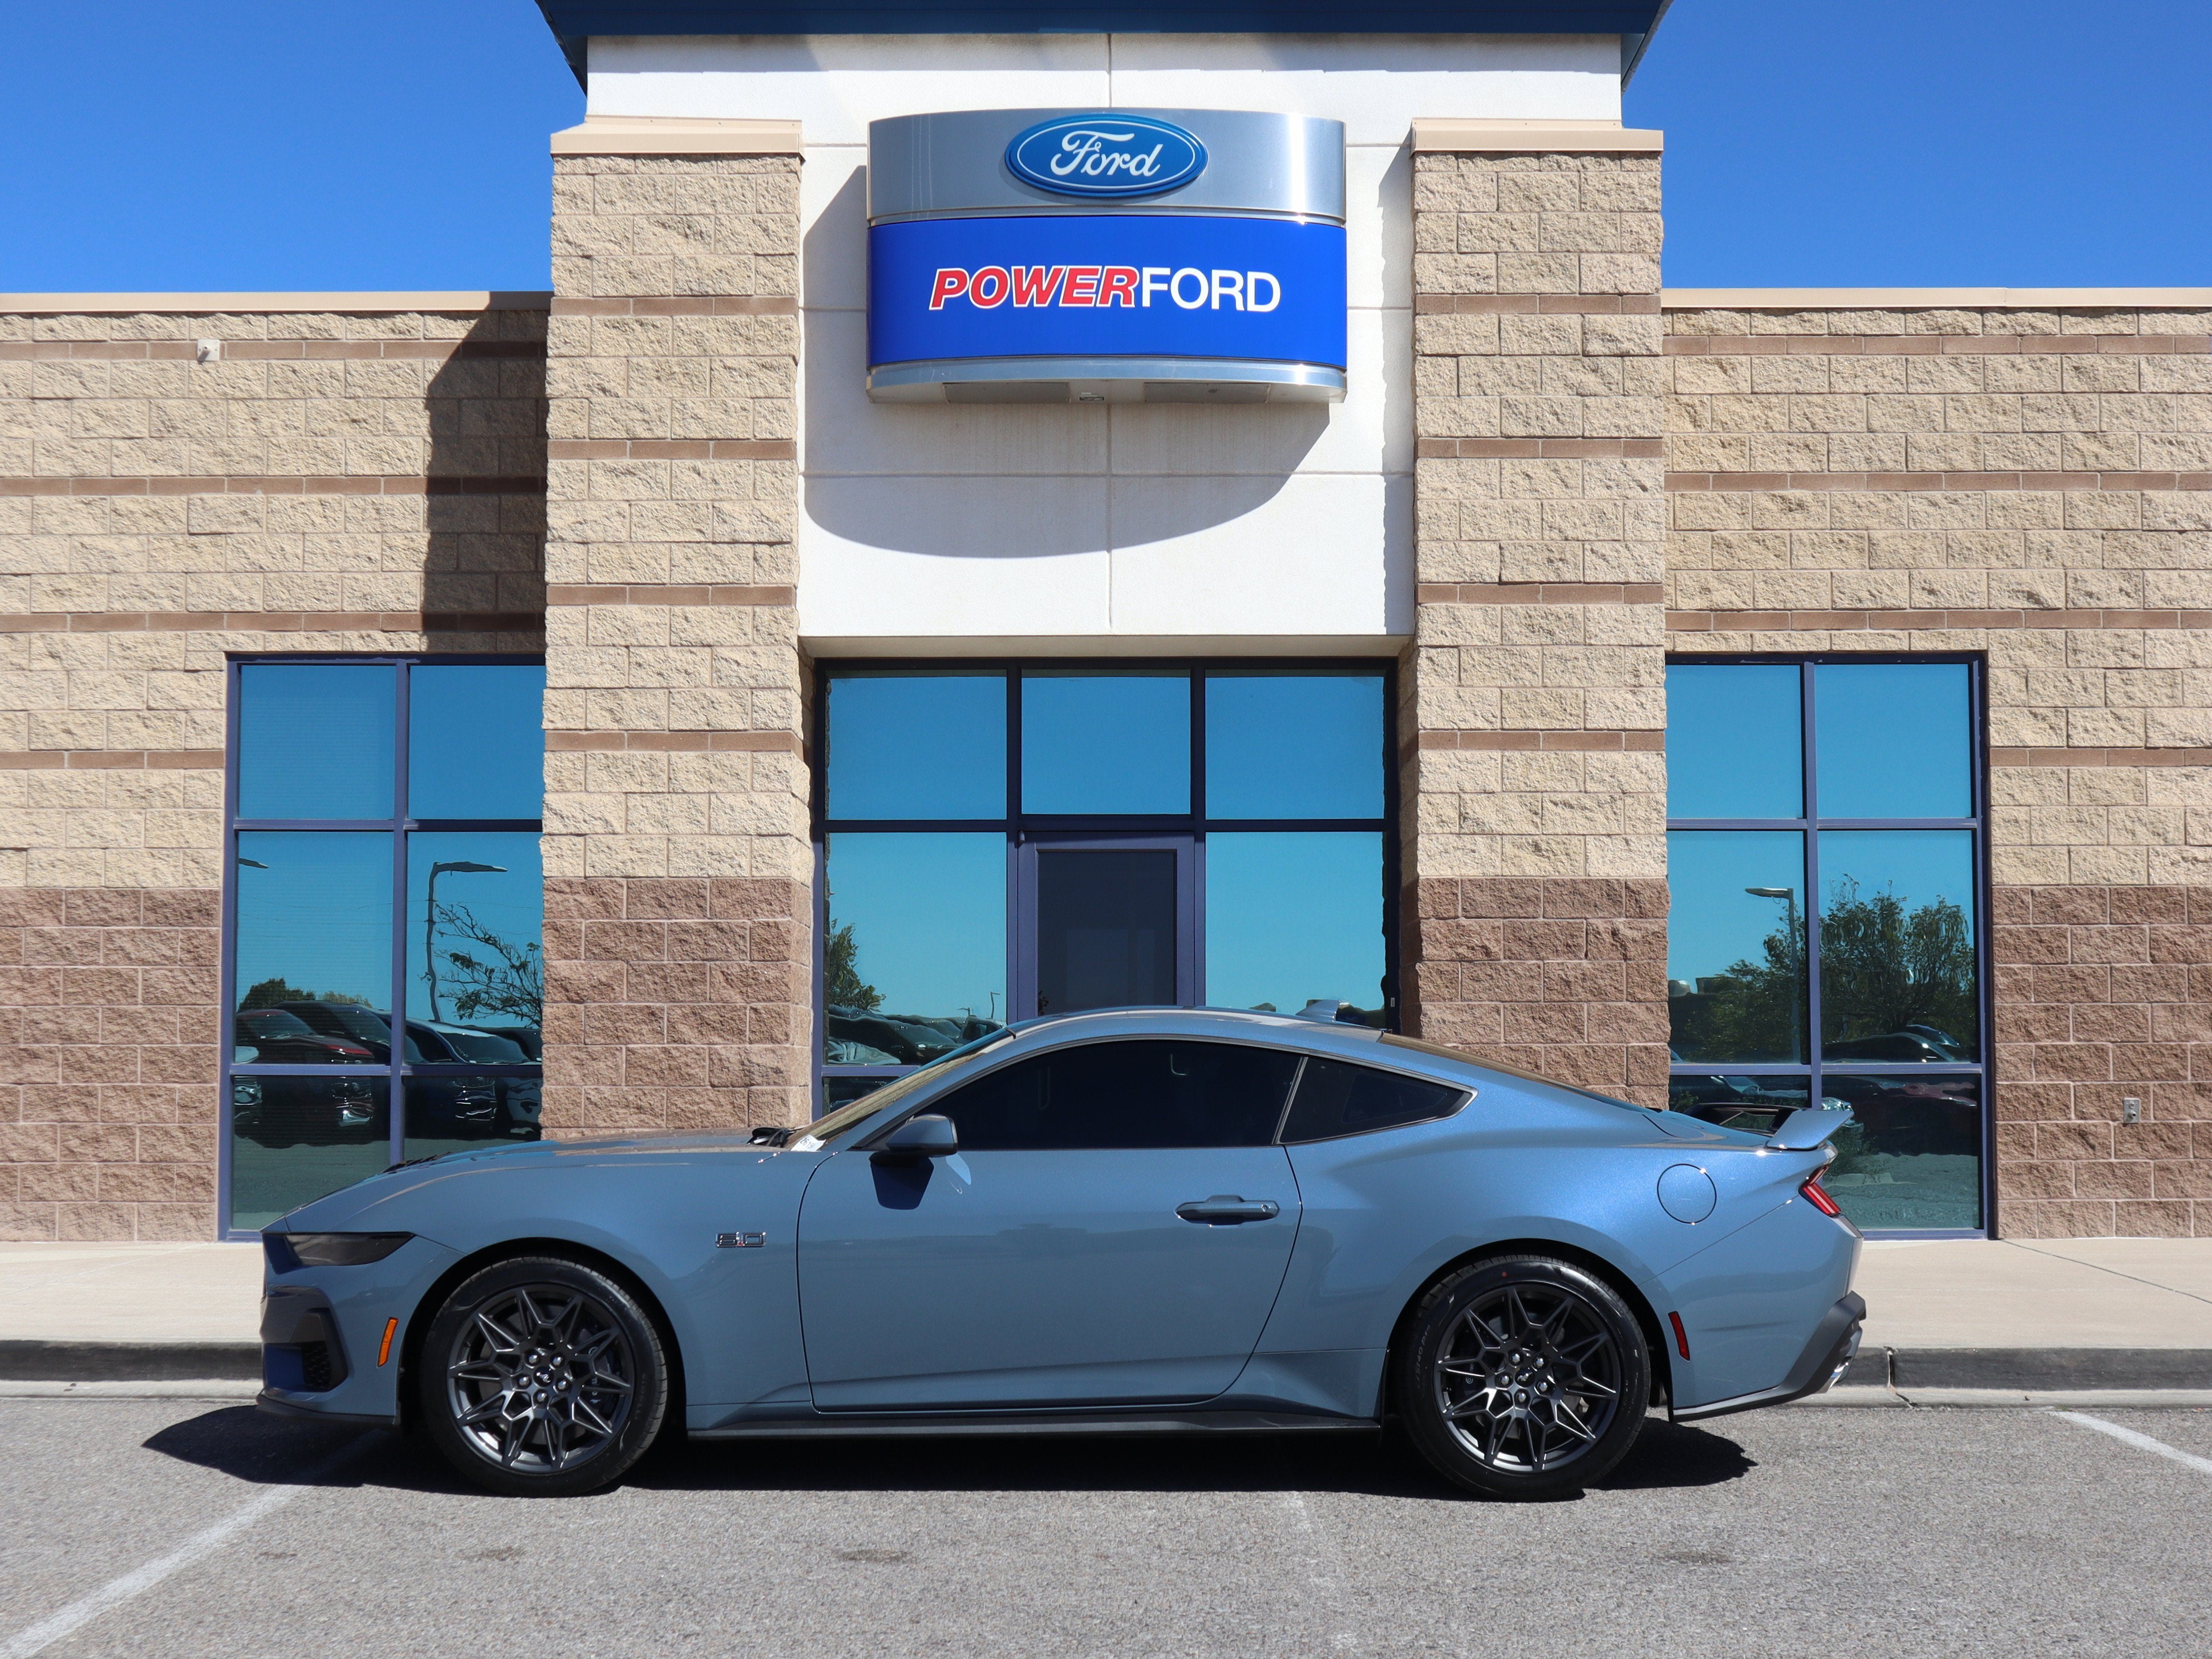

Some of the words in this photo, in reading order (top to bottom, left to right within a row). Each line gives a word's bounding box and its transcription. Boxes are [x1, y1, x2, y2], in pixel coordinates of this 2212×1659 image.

[1051, 131, 1163, 176] Ford
[929, 265, 1281, 313] POWERFORD
[715, 1231, 766, 1248] 5.0
